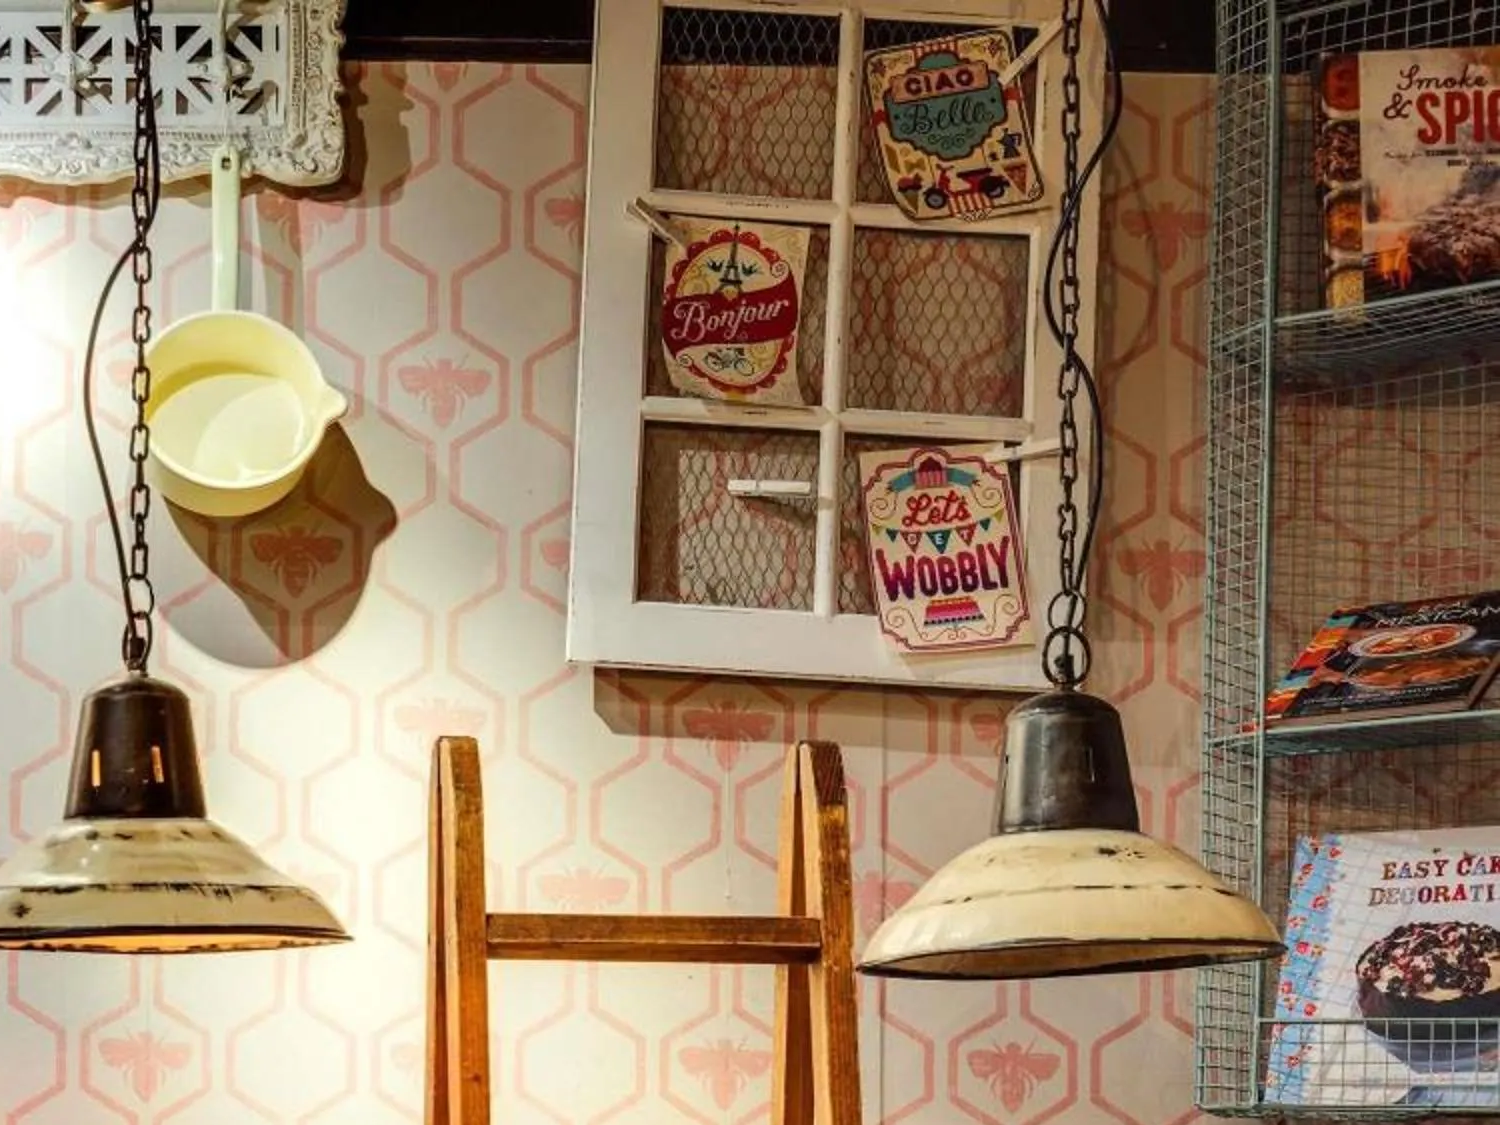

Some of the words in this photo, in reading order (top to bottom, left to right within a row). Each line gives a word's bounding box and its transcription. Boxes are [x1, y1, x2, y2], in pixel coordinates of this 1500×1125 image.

[905, 69, 975, 96] CIAO
[1396, 63, 1488, 91] Smoke
[1383, 92, 1412, 119] &
[670, 299, 789, 341] Bonjour
[907, 529, 970, 545] GET
[876, 536, 1010, 602] WOBBLY
[1382, 859, 1449, 880] EASY
